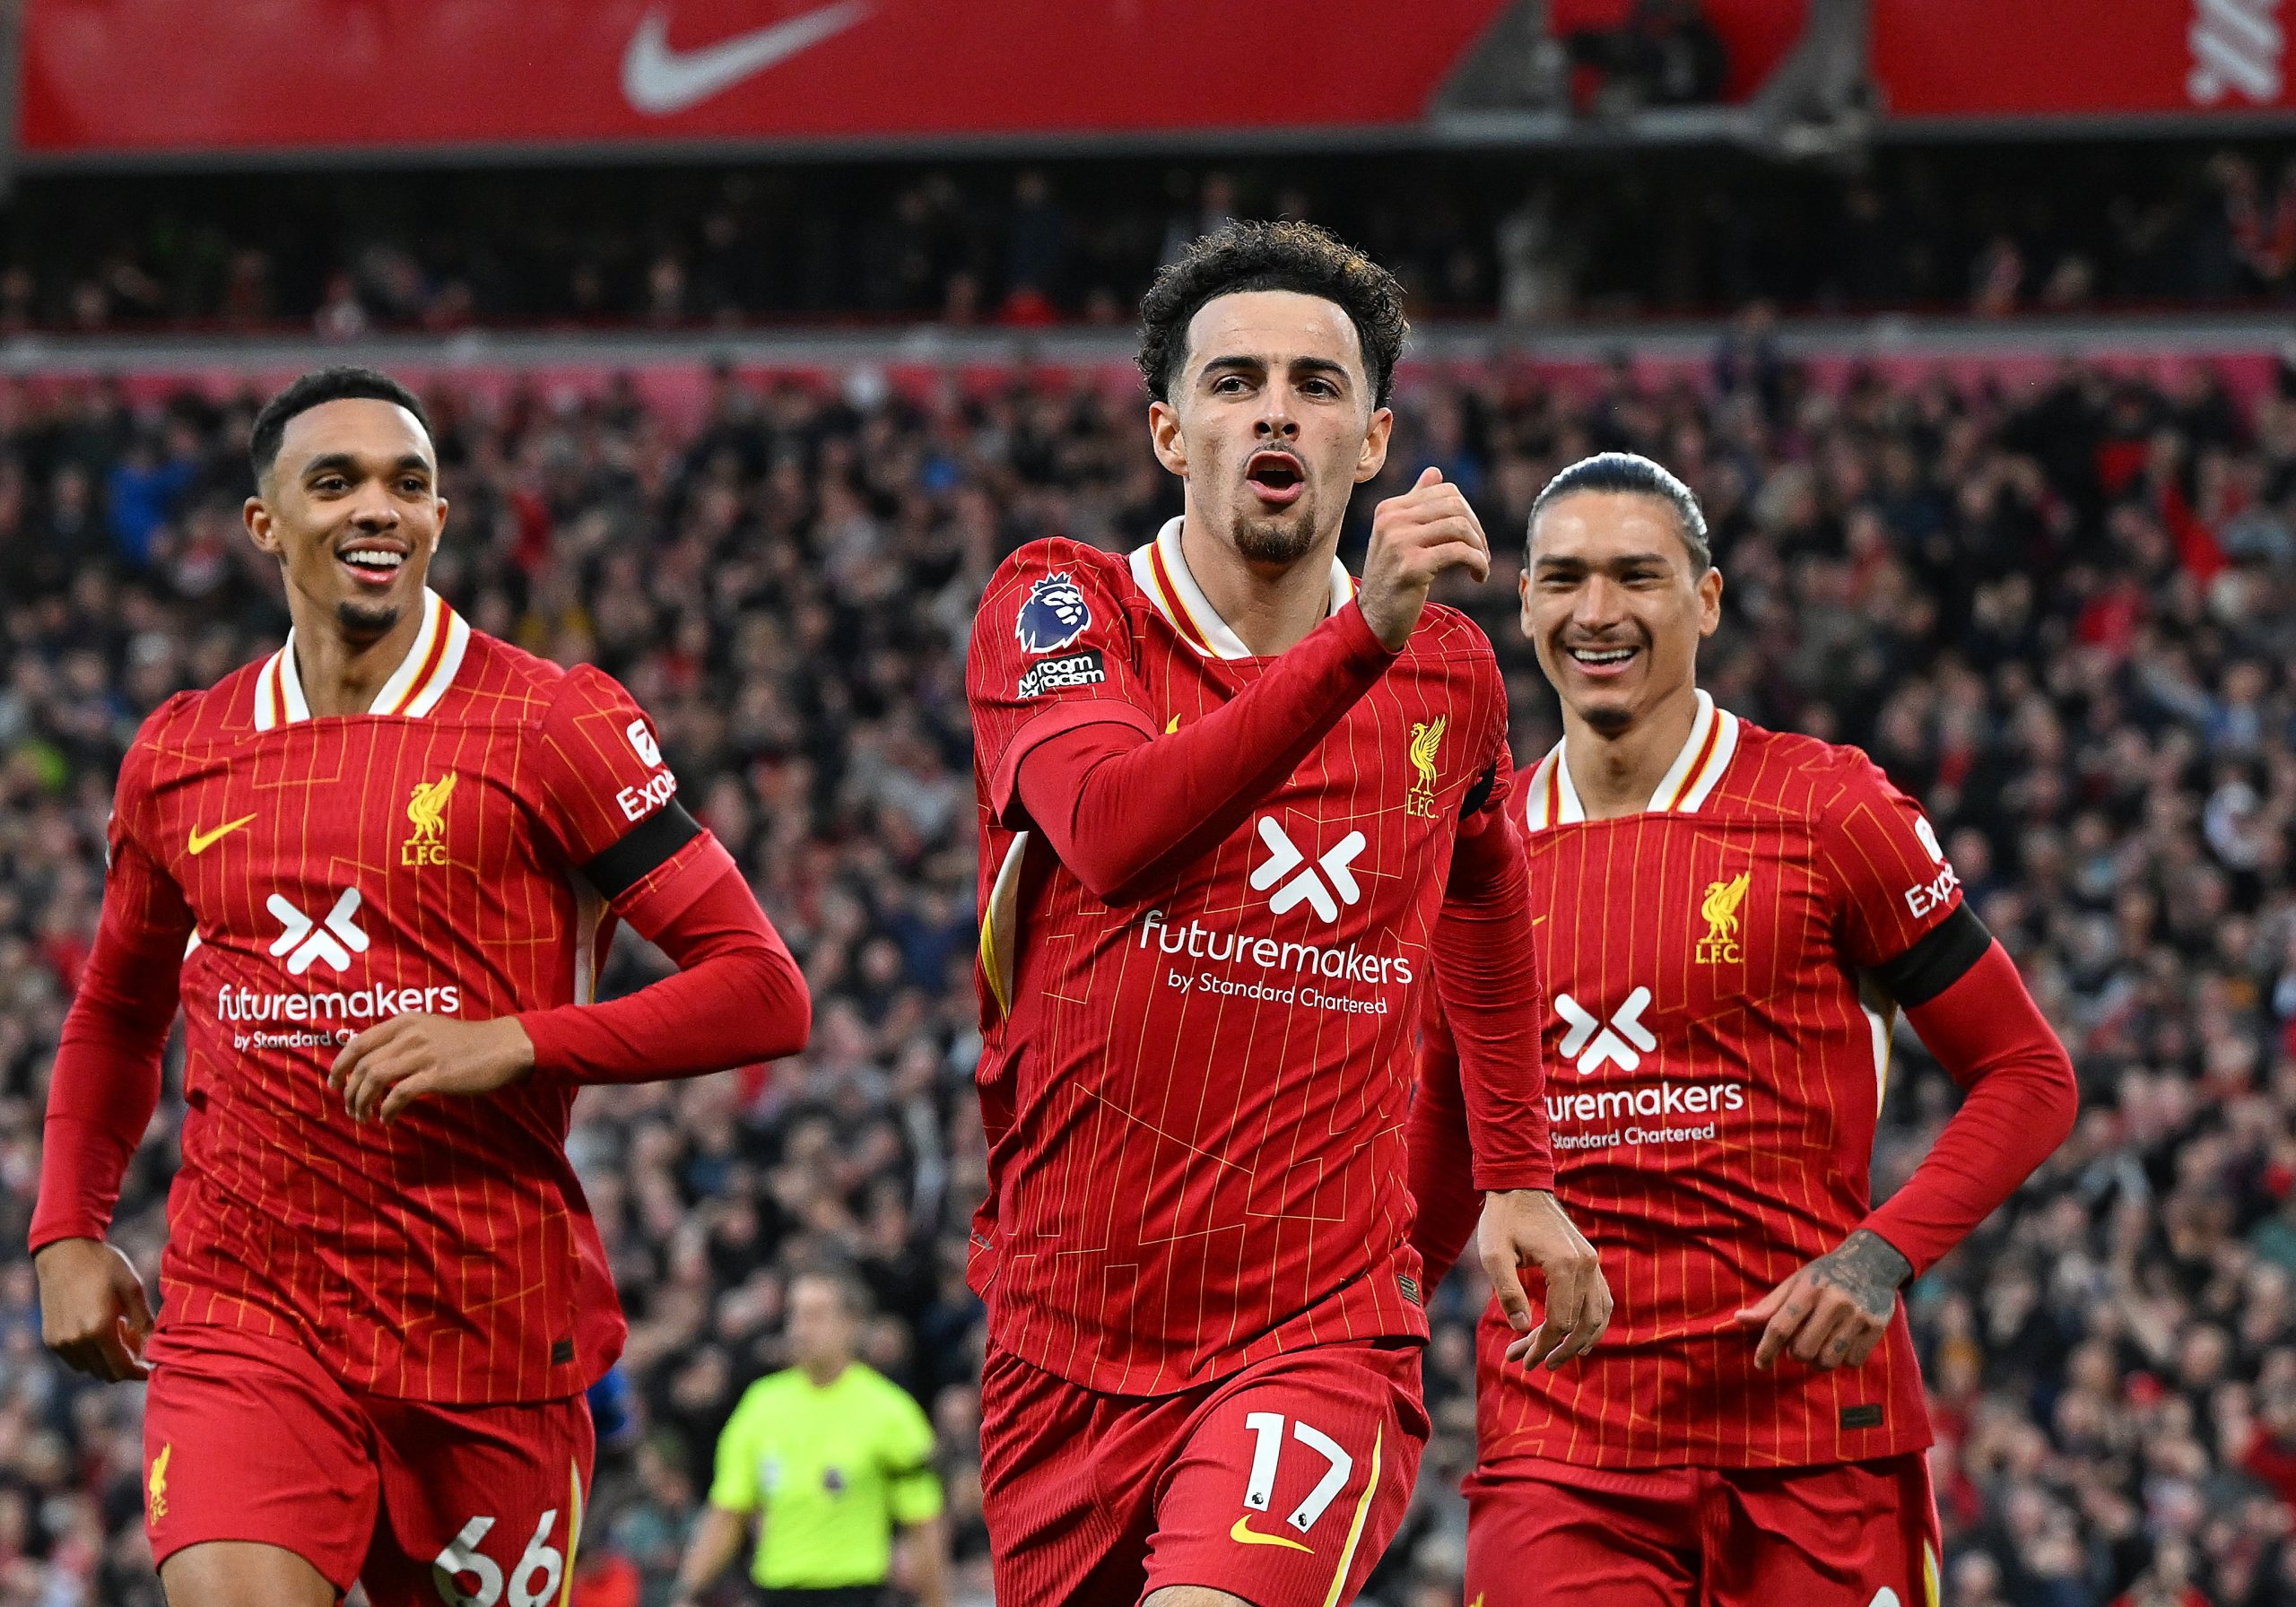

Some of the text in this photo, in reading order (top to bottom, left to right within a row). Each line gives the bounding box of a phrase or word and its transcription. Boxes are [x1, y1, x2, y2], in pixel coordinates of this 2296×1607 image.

[1018, 656, 1093, 695] No room
[1039, 669, 1106, 692] racism
[1139, 909, 1413, 985] futuremakers
[217, 982, 460, 1021] futuremakers
[1168, 968, 1388, 1015] by Standard Chartered
[233, 1032, 251, 1054] by
[253, 1029, 332, 1049] Standard
[1543, 1081, 1744, 1123] uremakers
[1551, 1121, 1716, 1150] Standard Chartered
[1243, 1412, 1353, 1534] 17
[431, 1508, 564, 1607] 66
